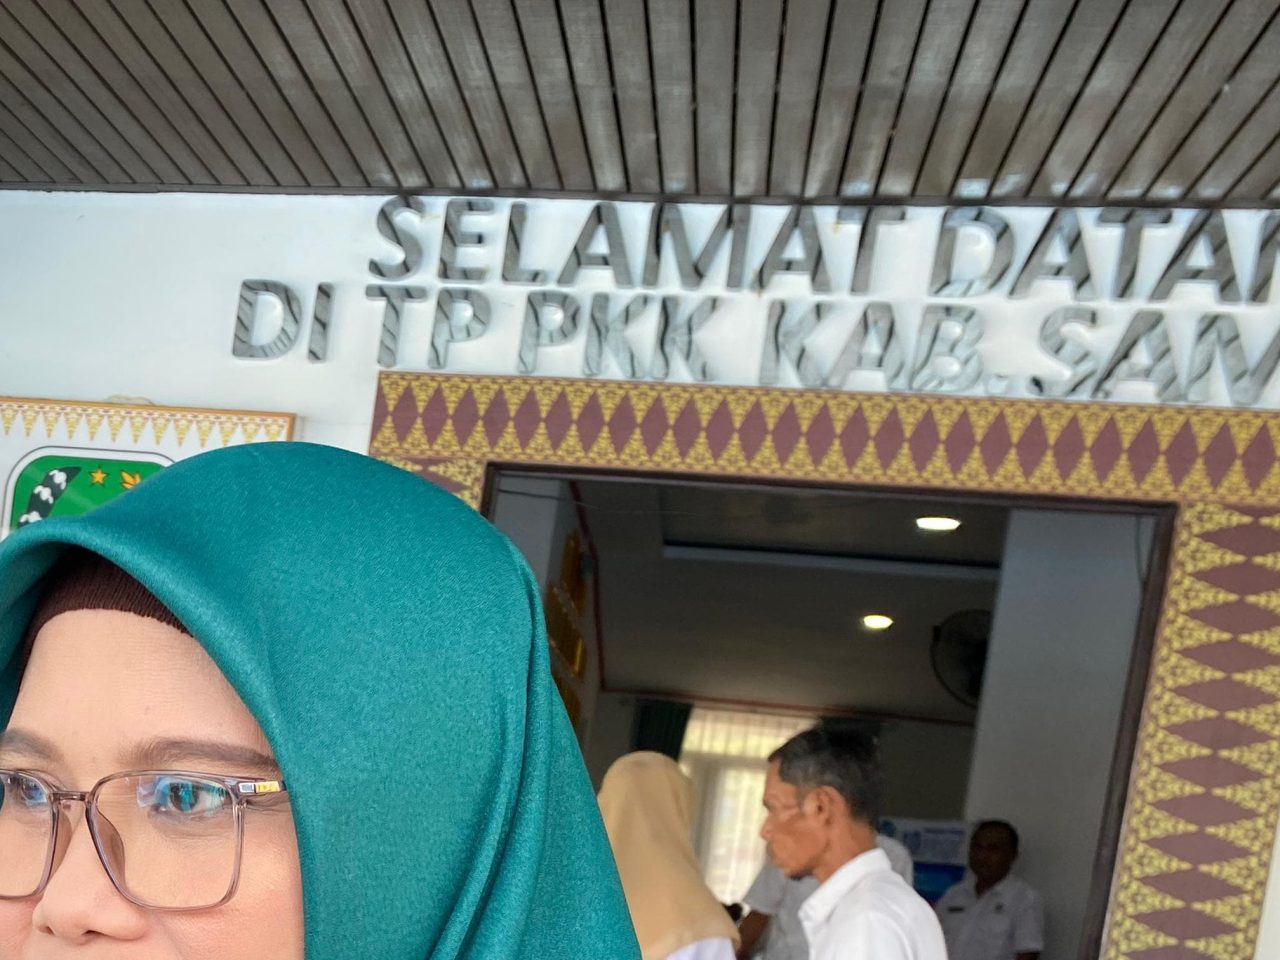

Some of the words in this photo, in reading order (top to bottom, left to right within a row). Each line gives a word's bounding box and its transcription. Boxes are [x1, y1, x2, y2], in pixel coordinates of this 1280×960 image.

[368, 194, 906, 295] SELAMAT
[232, 279, 334, 361] DI
[365, 284, 492, 368] TP
[517, 289, 723, 382] PKK
[759, 299, 1009, 393] KAB.
